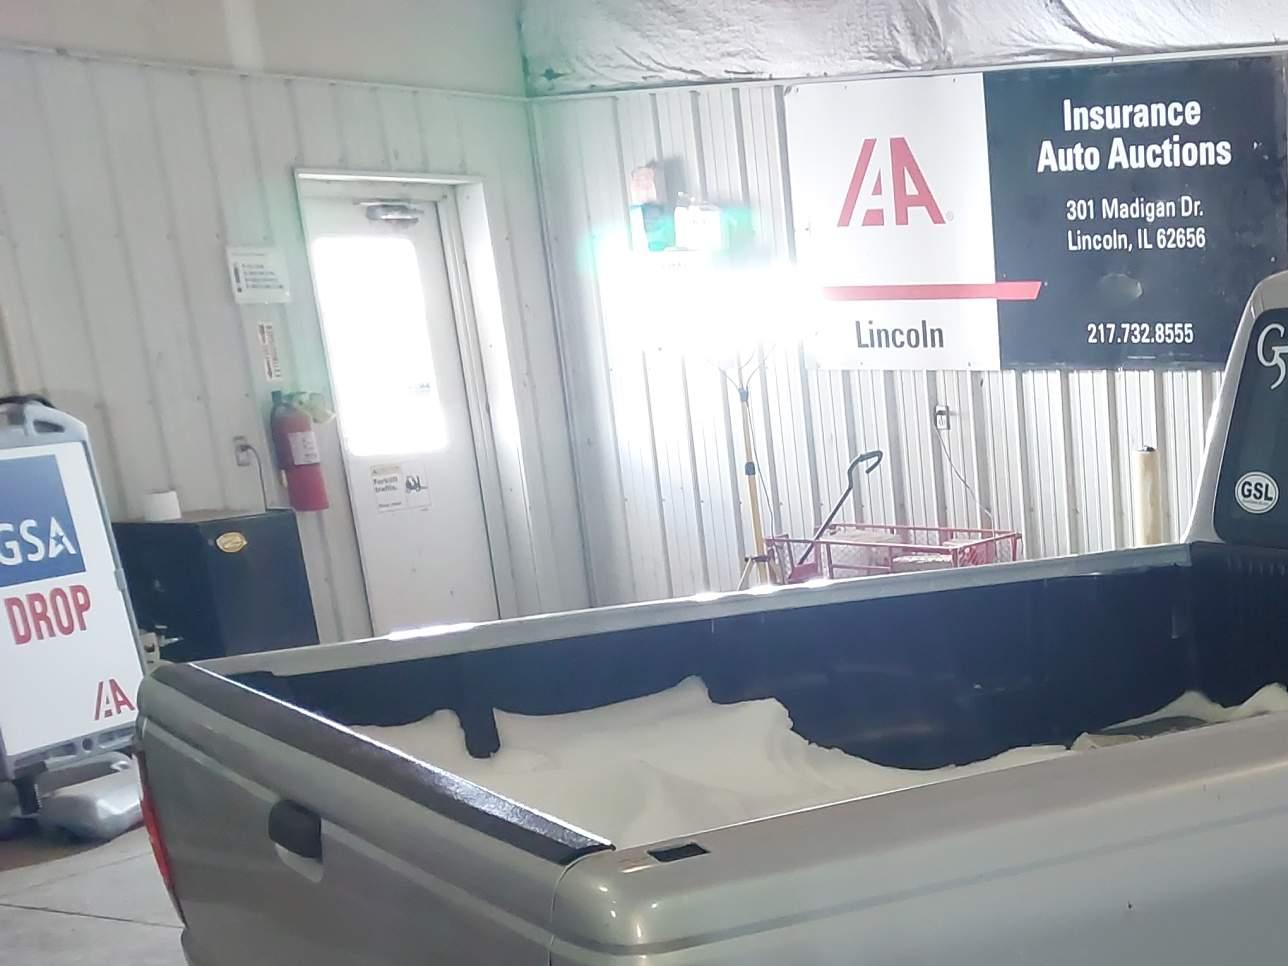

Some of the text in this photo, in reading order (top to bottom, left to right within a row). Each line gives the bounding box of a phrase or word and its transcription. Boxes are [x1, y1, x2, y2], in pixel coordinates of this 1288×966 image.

[1063, 98, 1202, 132] Insurance
[1037, 134, 1233, 173] Auto Auctions
[1066, 195, 1204, 223] 301 Madigan Dr.
[1067, 227, 1207, 252] Lincoln, IL 62656
[855, 319, 945, 350] Lincoln
[1087, 322, 1194, 344] 217.732.8555
[1241, 480, 1274, 502] GSL
[0, 516, 77, 566] GSA
[5, 584, 92, 645] DROP
